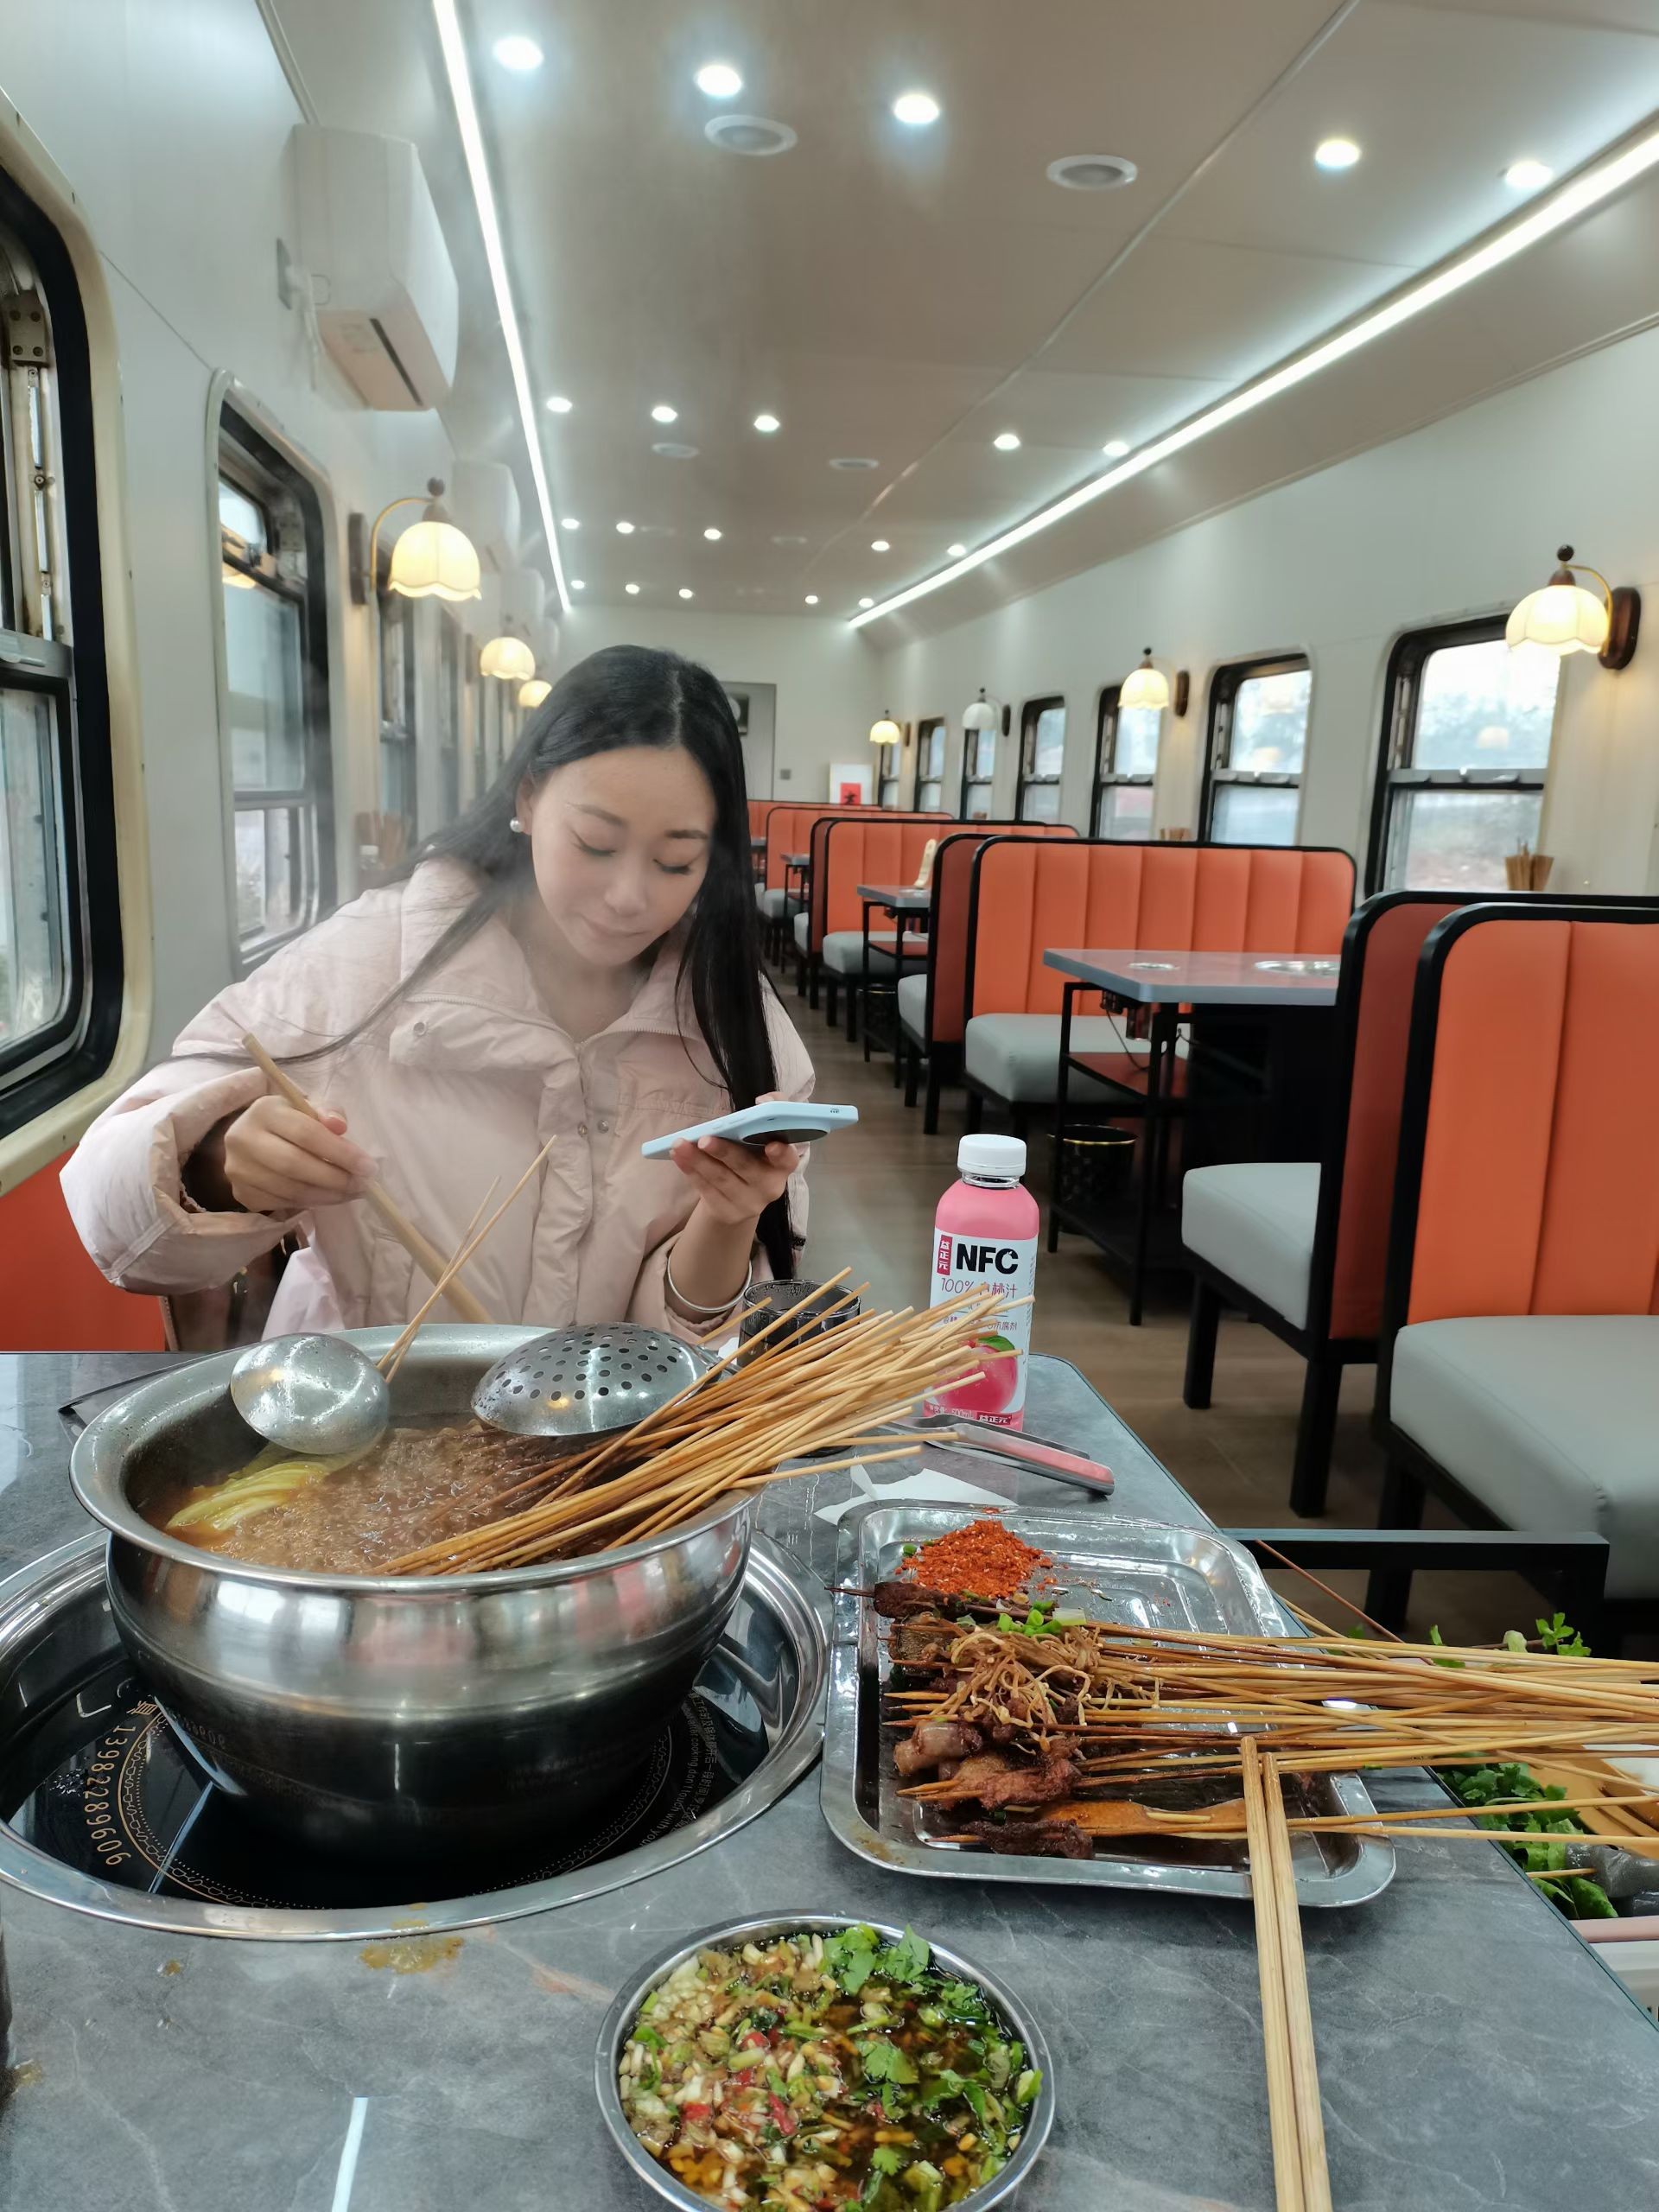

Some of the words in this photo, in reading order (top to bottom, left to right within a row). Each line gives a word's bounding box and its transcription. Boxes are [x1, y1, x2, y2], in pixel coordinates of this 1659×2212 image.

[956, 1243, 1019, 1274] NFC
[941, 1277, 974, 1294] 100%
[82, 1724, 137, 1866] 13982289606
